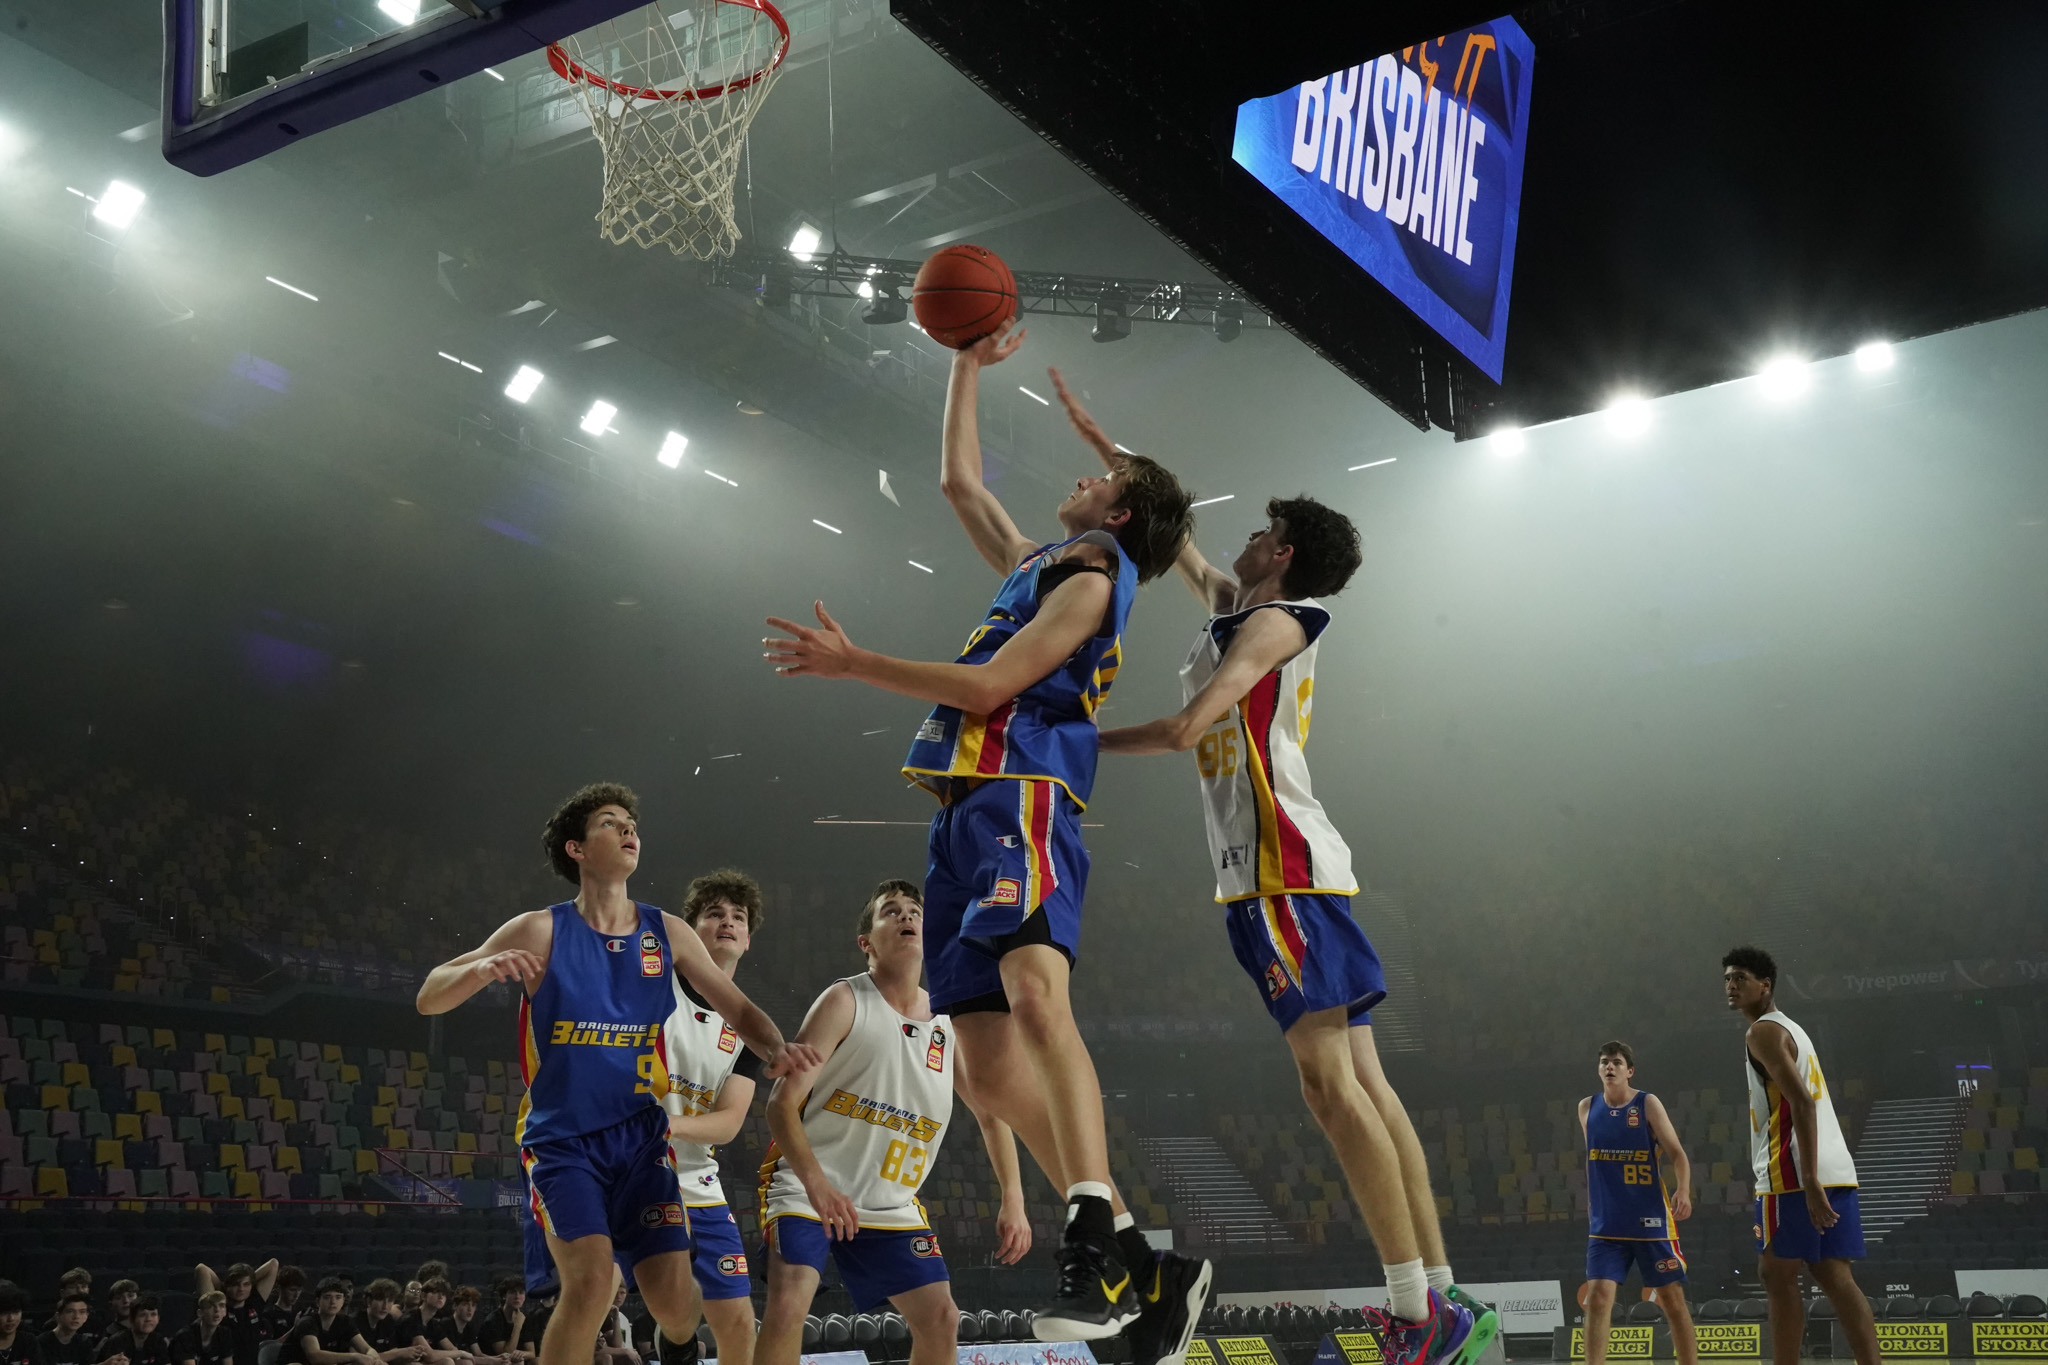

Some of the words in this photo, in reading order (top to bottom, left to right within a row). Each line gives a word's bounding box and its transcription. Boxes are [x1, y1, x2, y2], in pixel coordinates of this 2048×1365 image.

[1453, 33, 1496, 117] IT
[1291, 53, 1486, 266] BRISBANE
[643, 938, 657, 948] NBL
[1842, 970, 1948, 994] Tyrepower
[577, 1021, 647, 1032] BRISBANE
[859, 1097, 918, 1120] BRISBANE
[822, 1088, 943, 1143] BULLETS
[1588, 1149, 1650, 1162] BULLETS
[880, 1138, 928, 1188] 83
[1623, 1164, 1653, 1185] 85
[916, 1241, 930, 1251] NBL
[722, 1260, 735, 1270] NBL
[1574, 1329, 1650, 1339] NONAL
[1695, 1326, 1757, 1338] TIONAL
[1875, 1325, 1944, 1336] TIONAL
[1976, 1325, 2048, 1336] NATION
[1220, 1340, 1267, 1352] NATIONAL
[1338, 1335, 1376, 1347] NATIONAL
[1697, 1340, 1754, 1352] ORAGE
[1879, 1340, 1941, 1351] ORAGE
[1576, 1343, 1647, 1354] SRAGE
[1230, 1355, 1274, 1365] STORAGE
